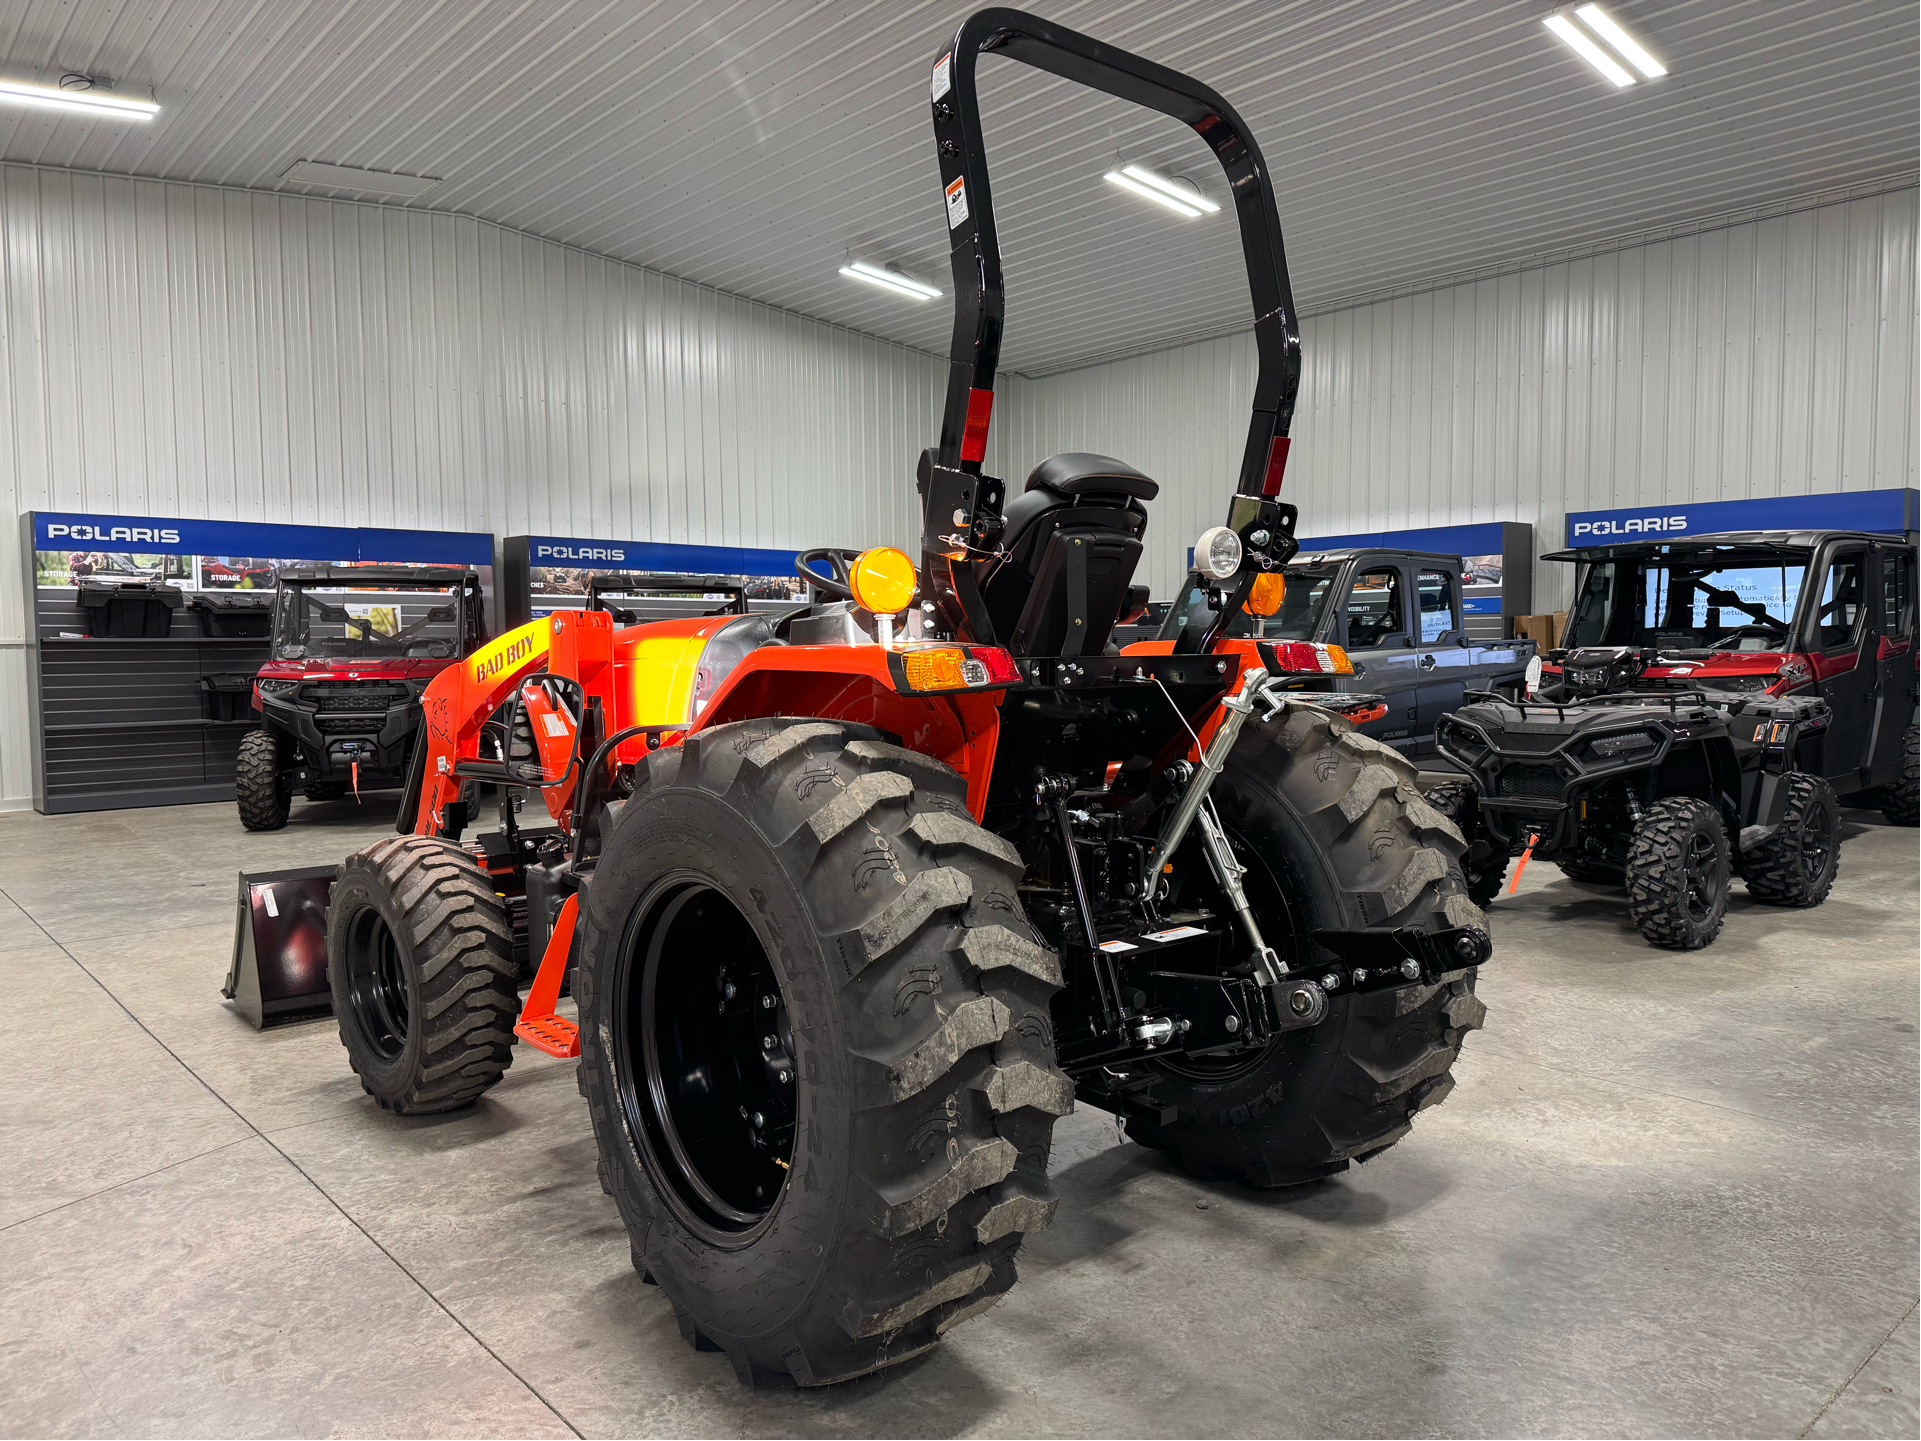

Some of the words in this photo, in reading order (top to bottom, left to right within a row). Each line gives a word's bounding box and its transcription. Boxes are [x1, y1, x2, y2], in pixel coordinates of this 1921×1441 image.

[1574, 515, 1688, 536] POLARIS
[47, 523, 180, 544] POLARIS
[537, 545, 625, 561] POLARIS
[43, 570, 79, 578] STORAGE
[210, 574, 241, 582] STORAGE
[476, 652, 504, 684] BAD
[506, 632, 535, 666] BOY
[1787, 663, 1807, 678] XP
[1383, 730, 1408, 739] POLARIS
